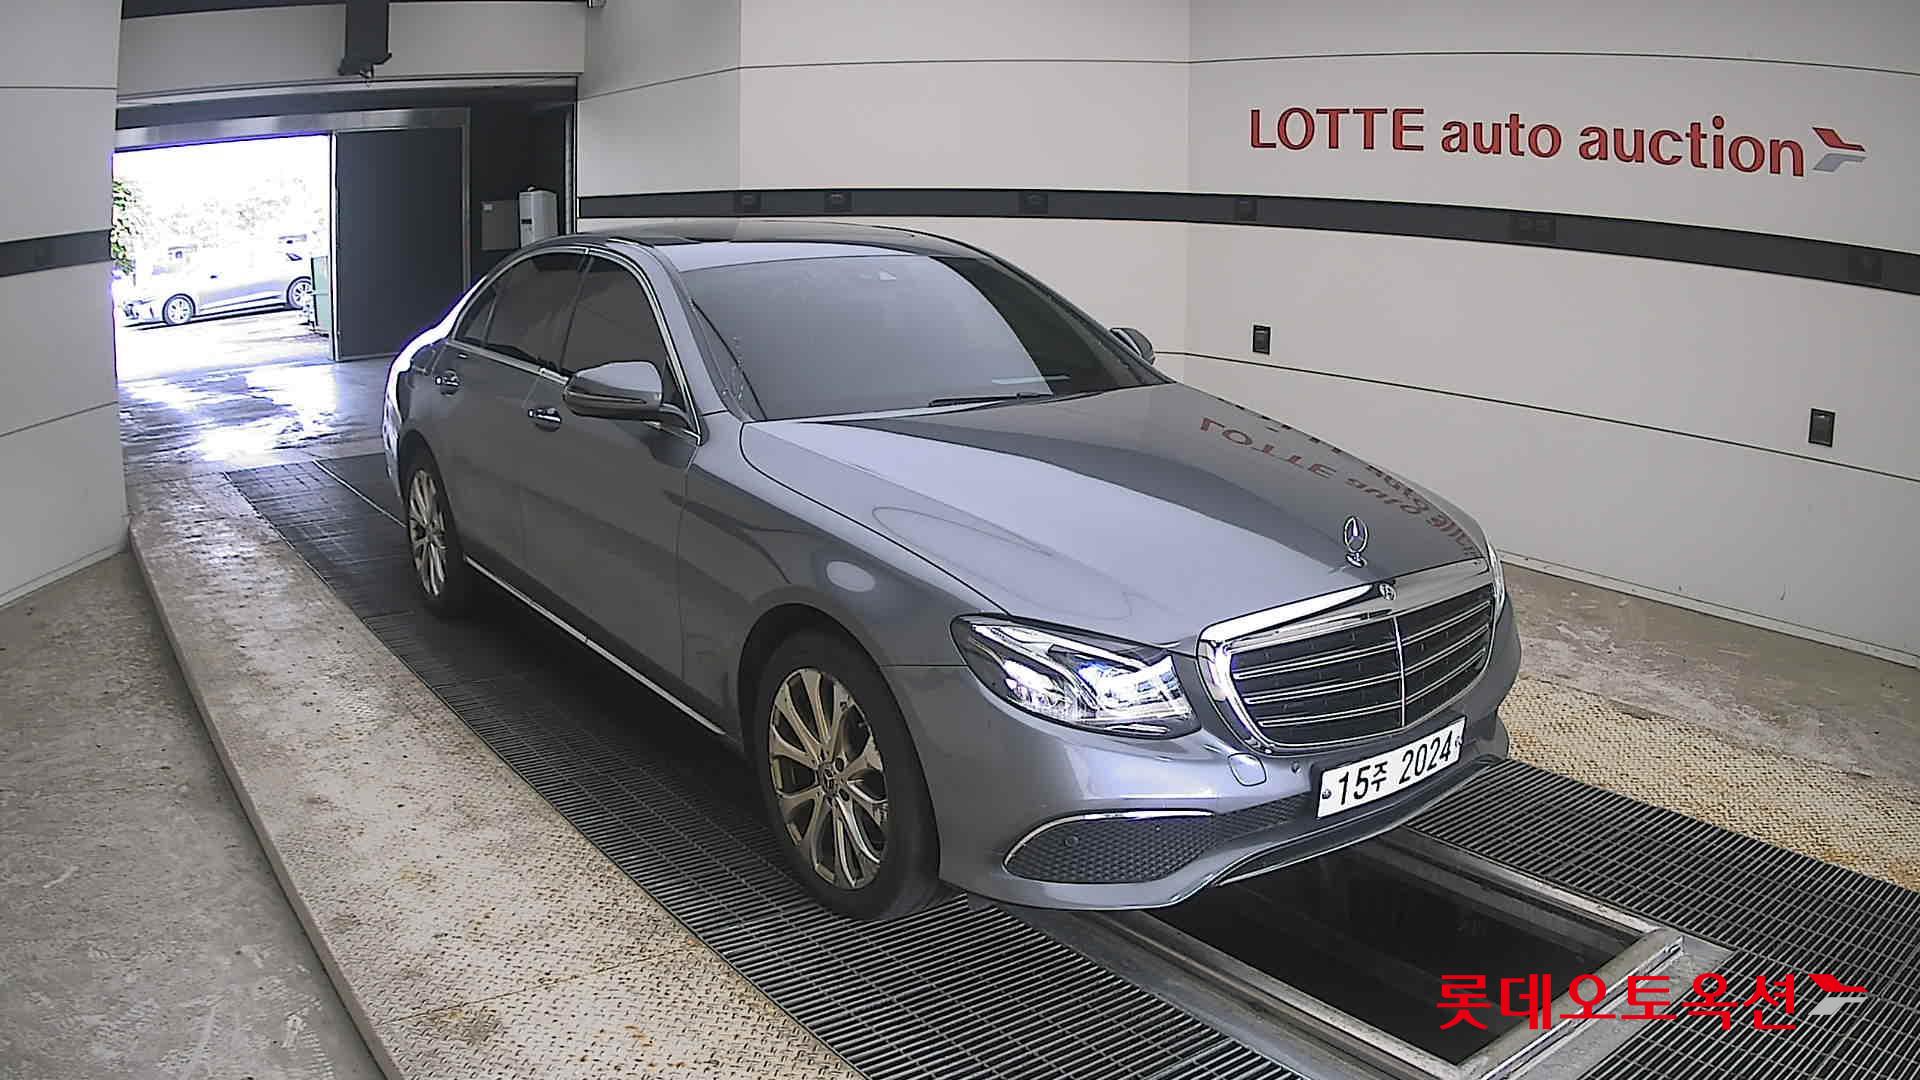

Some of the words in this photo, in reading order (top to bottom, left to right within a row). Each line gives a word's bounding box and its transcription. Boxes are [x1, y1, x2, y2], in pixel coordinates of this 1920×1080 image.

[1249, 107, 1425, 151] LOTTE
[1440, 113, 1562, 159] auto
[1577, 115, 1805, 177] auction
[1338, 760, 1388, 805] 15주
[1398, 730, 1453, 785] 2024
